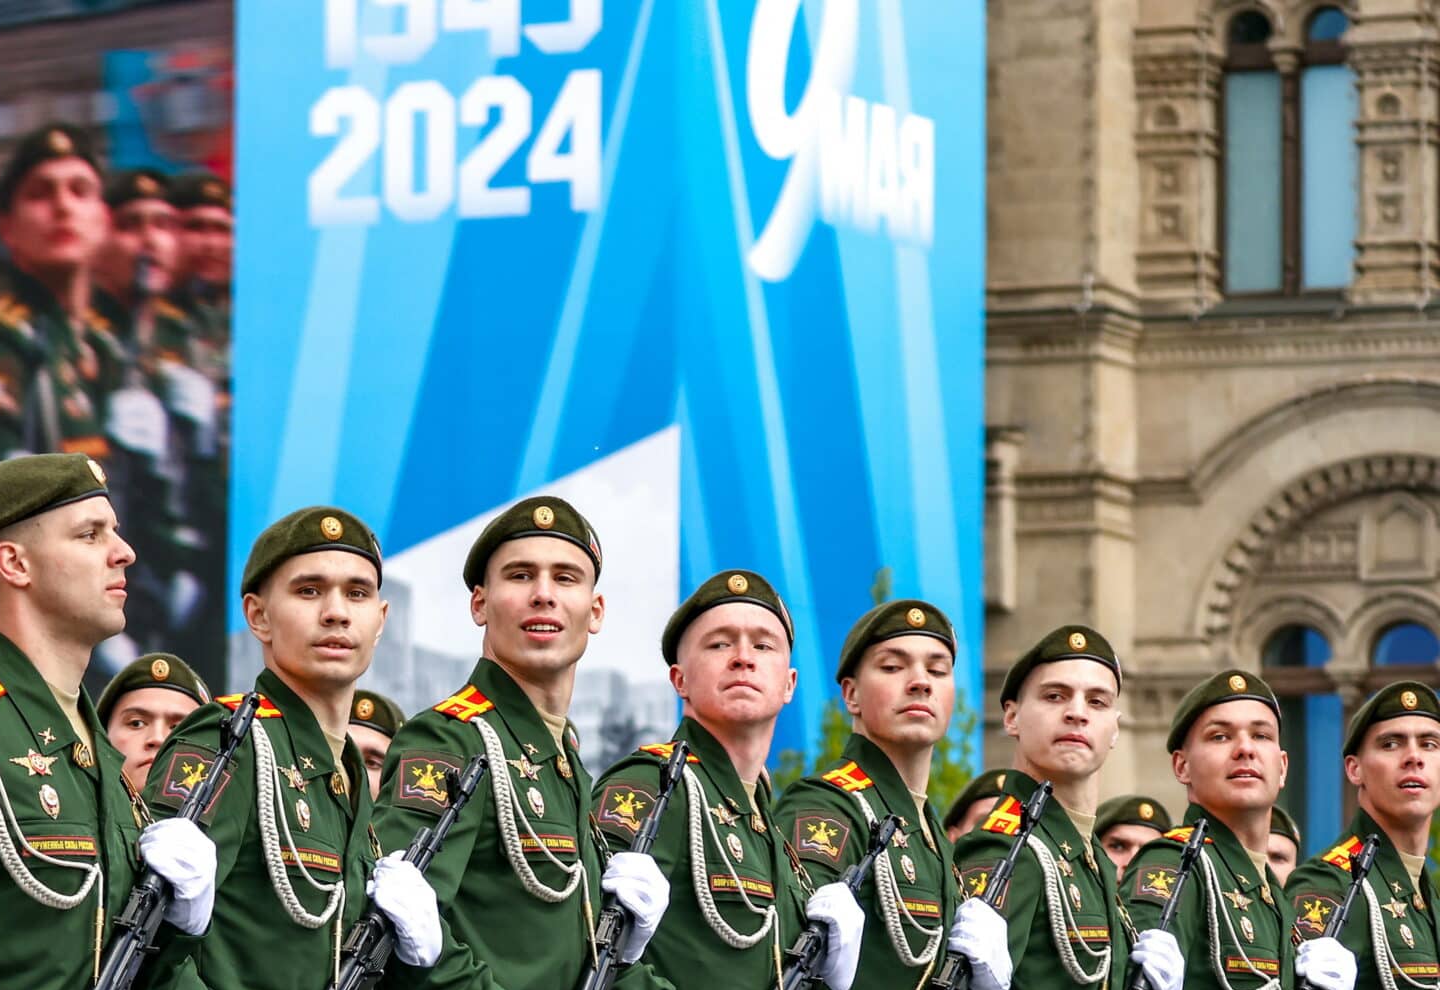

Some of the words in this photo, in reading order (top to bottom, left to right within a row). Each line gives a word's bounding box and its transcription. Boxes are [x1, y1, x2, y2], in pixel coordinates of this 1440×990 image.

[307, 68, 603, 229] 2024
[746, 0, 861, 283] 9
[815, 92, 936, 249] МАЯ
